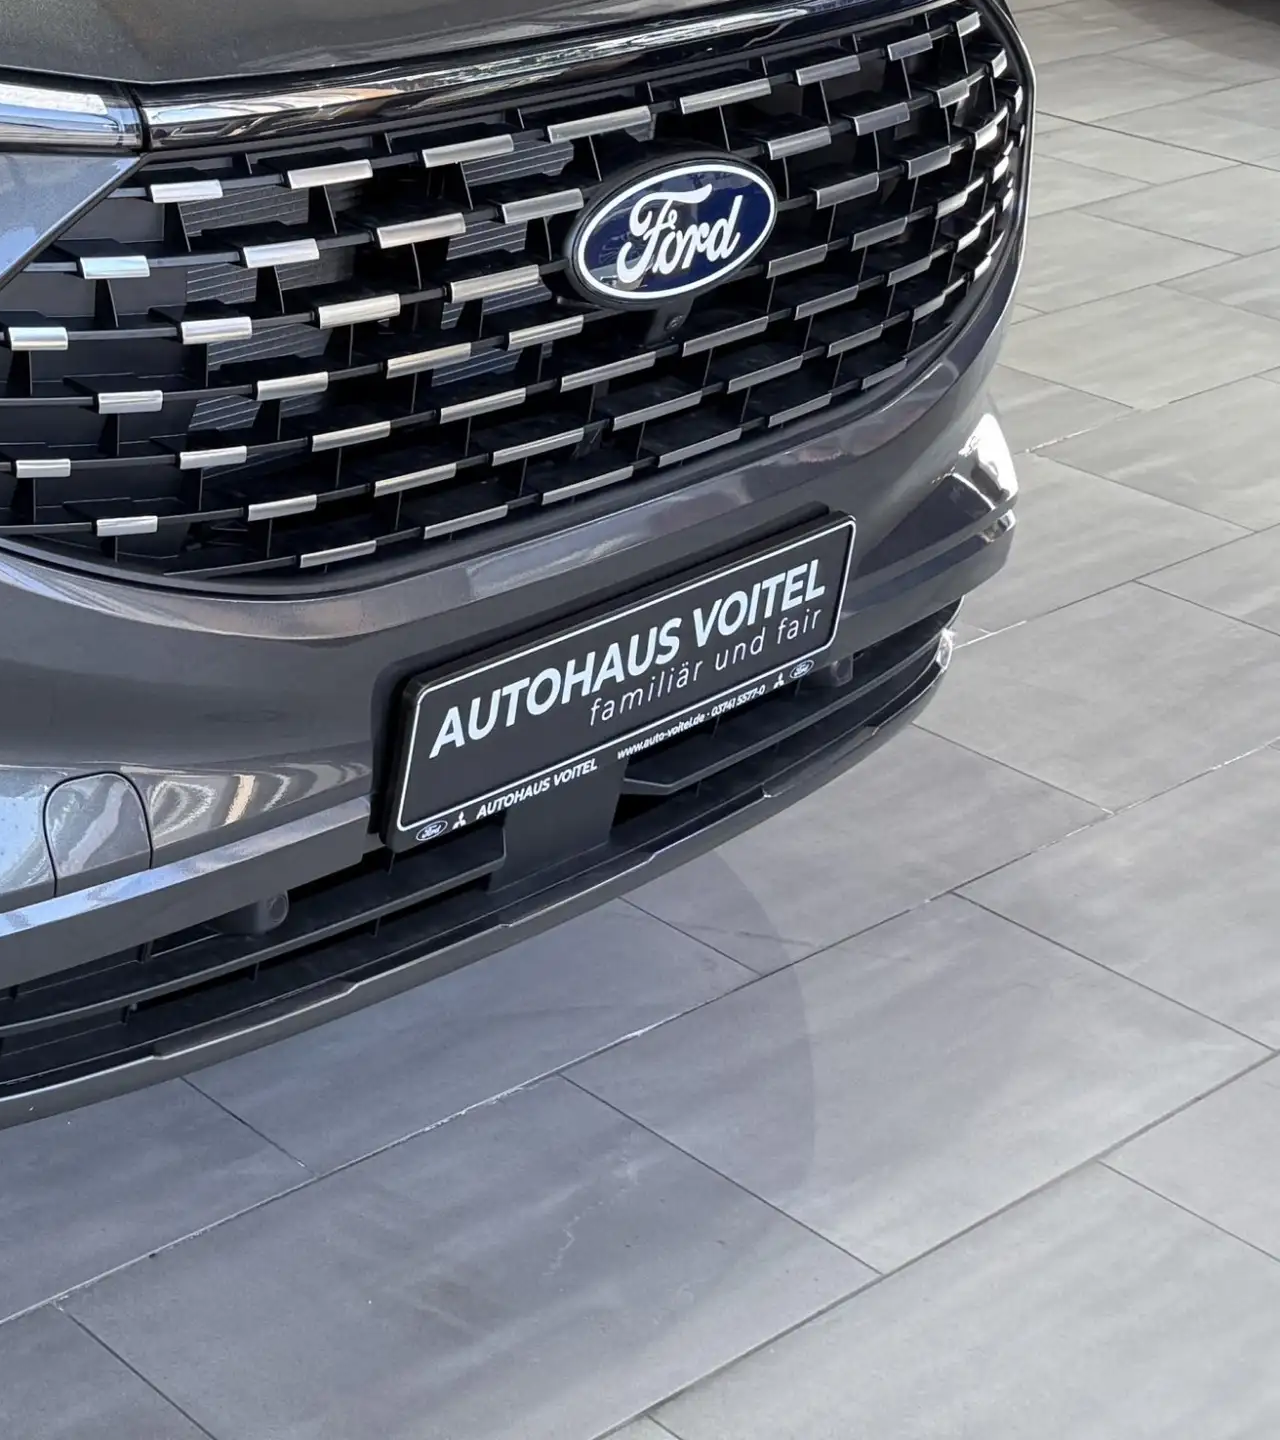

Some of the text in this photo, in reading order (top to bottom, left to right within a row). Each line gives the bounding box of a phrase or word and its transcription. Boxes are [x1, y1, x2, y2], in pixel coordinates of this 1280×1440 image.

[616, 183, 744, 284] Ford
[428, 559, 826, 759] AUTOHAUS VOITEL
[589, 606, 822, 727] familiär und fair
[476, 777, 551, 820] AUTOHAUS
[553, 757, 598, 787] VOITEL
[617, 712, 706, 760] www.auto-voitel.de
